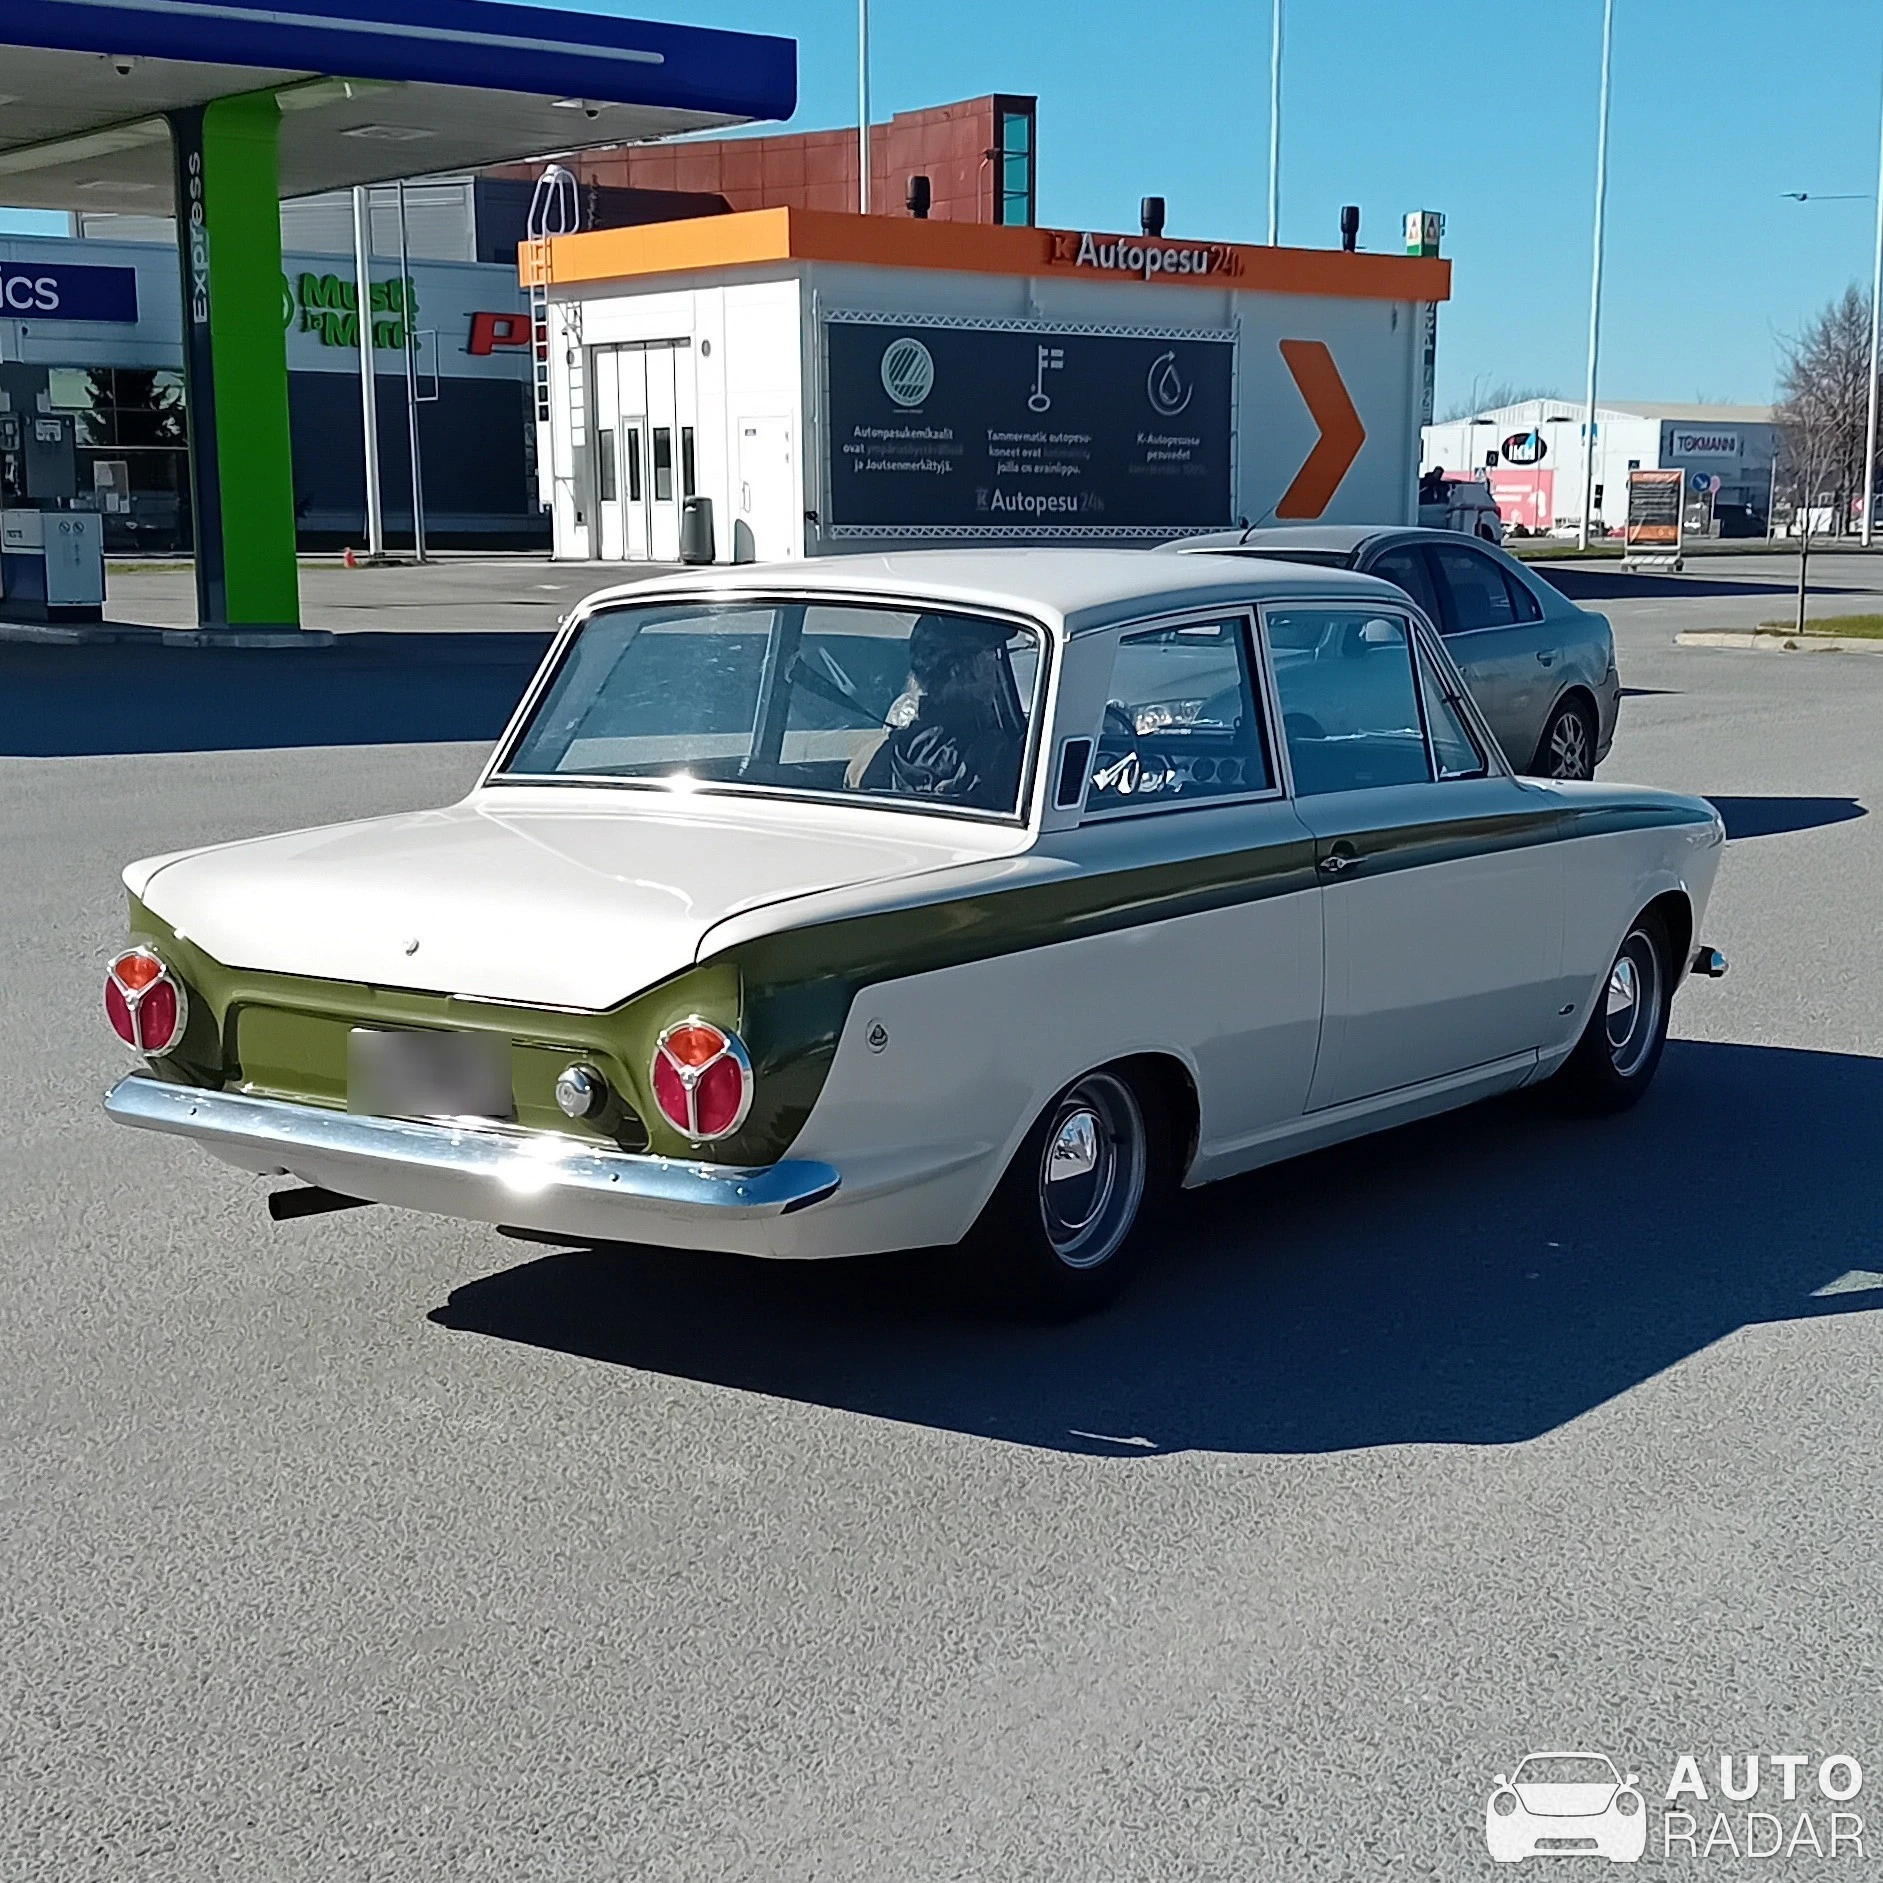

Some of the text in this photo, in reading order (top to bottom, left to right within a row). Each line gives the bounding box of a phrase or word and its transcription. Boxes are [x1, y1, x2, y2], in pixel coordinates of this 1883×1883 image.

[189, 151, 209, 324] Express
[1076, 232, 1208, 281] Autopesu
[991, 488, 1078, 518] Autopesu
